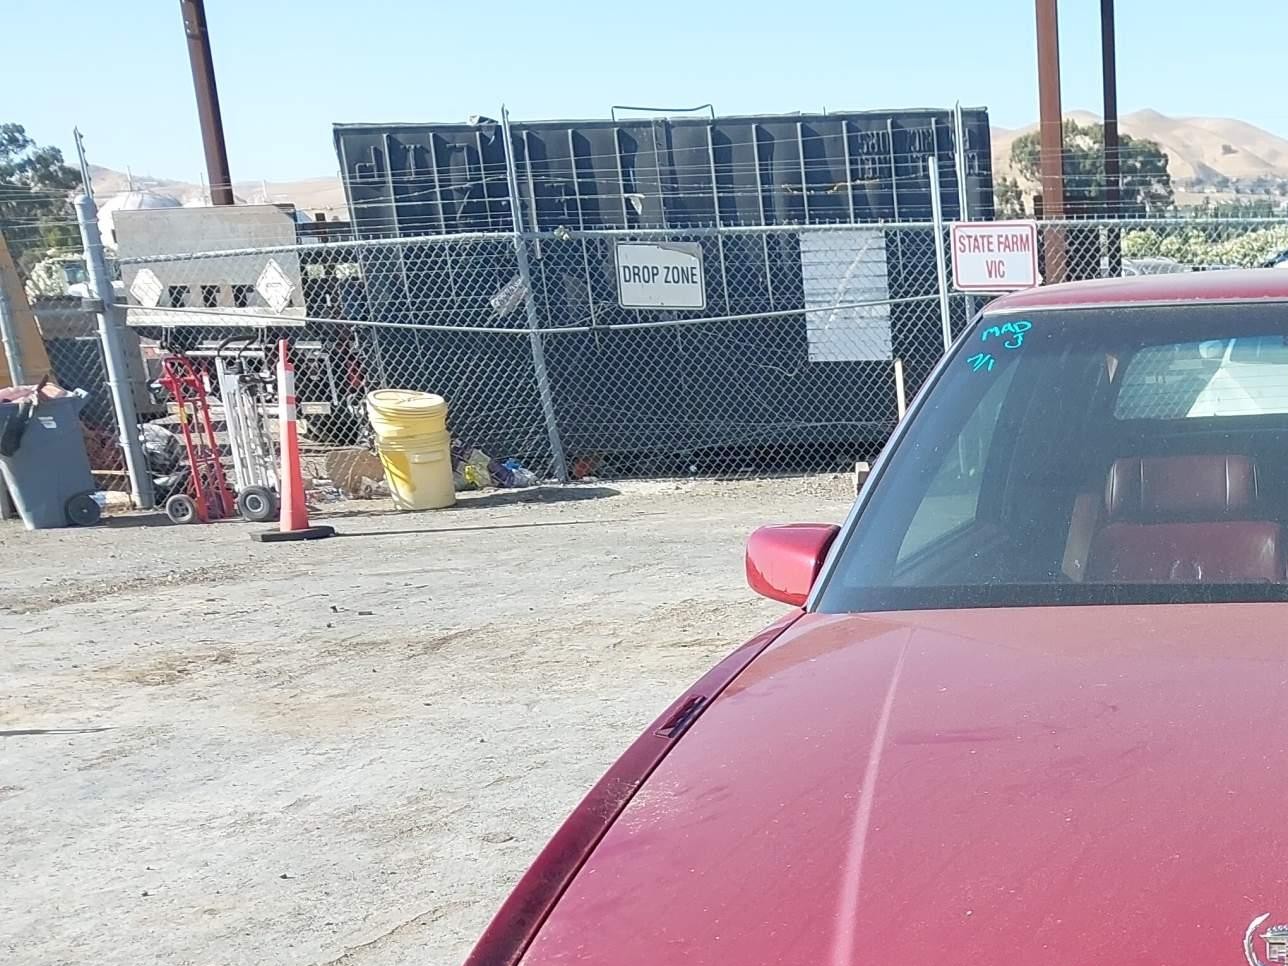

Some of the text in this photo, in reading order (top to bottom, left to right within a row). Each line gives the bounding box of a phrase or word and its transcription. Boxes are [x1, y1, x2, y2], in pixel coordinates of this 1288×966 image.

[958, 233, 1031, 253] STATE FARM
[623, 265, 699, 284] DROP ZONE
[985, 259, 1006, 279] VIC
